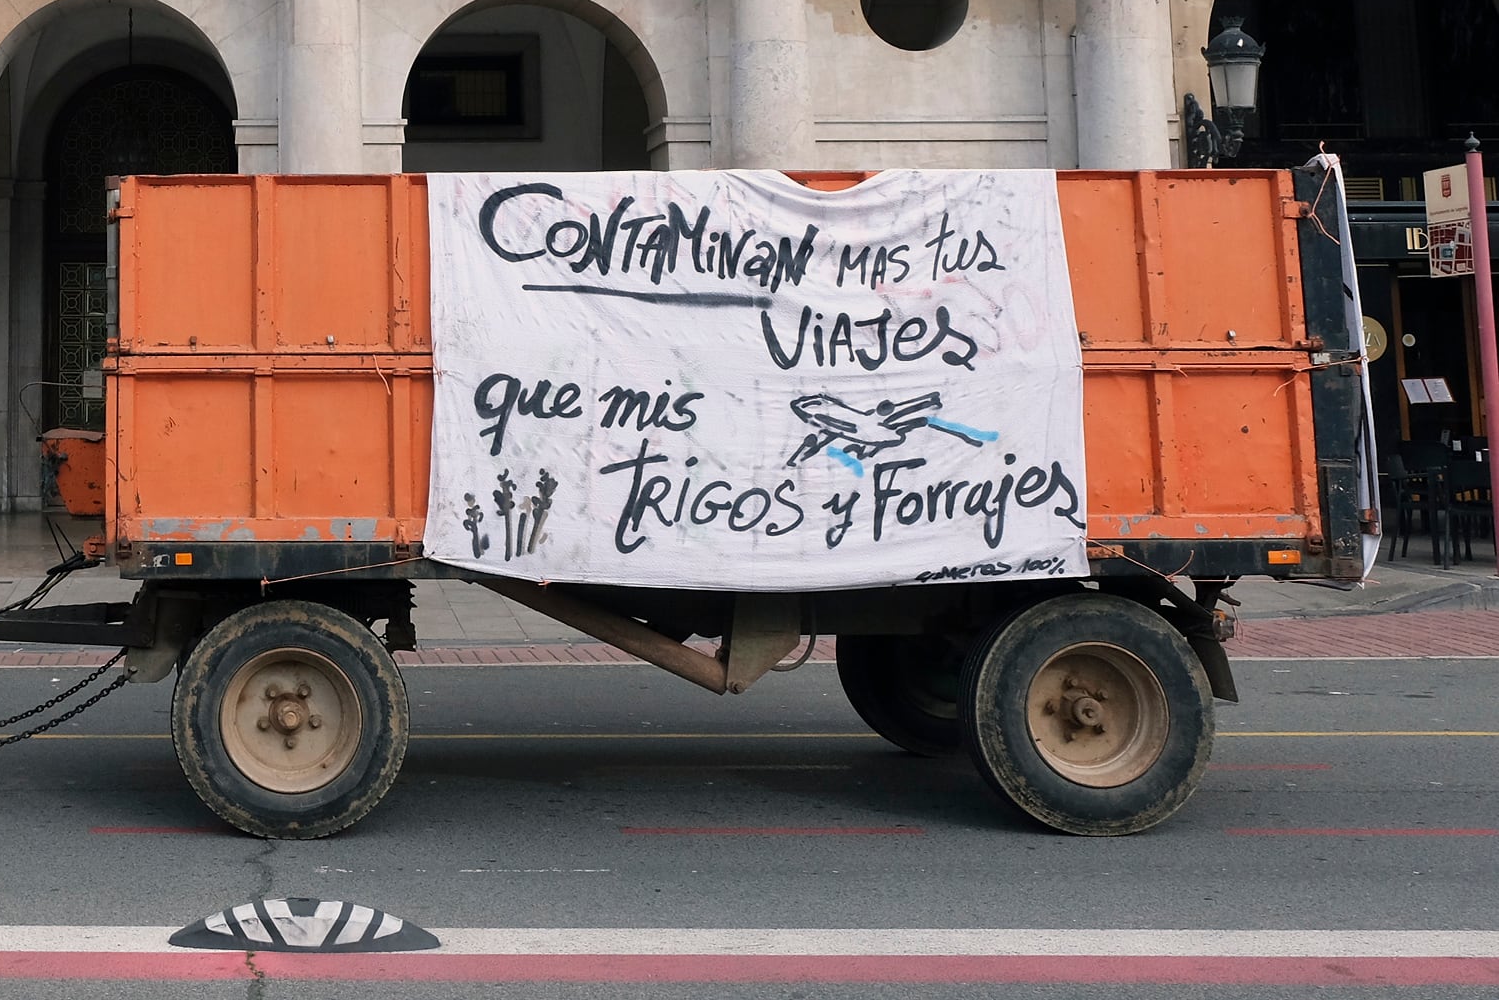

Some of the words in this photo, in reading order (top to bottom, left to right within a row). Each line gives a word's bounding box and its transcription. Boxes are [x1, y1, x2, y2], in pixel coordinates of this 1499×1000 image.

[836, 244, 910, 290] MAS
[925, 211, 1006, 281] tus
[474, 372, 583, 457] que
[598, 379, 705, 431] mis
[822, 490, 861, 550] y
[872, 453, 1086, 550] Forrajes
[1016, 556, 1066, 576] 100%
